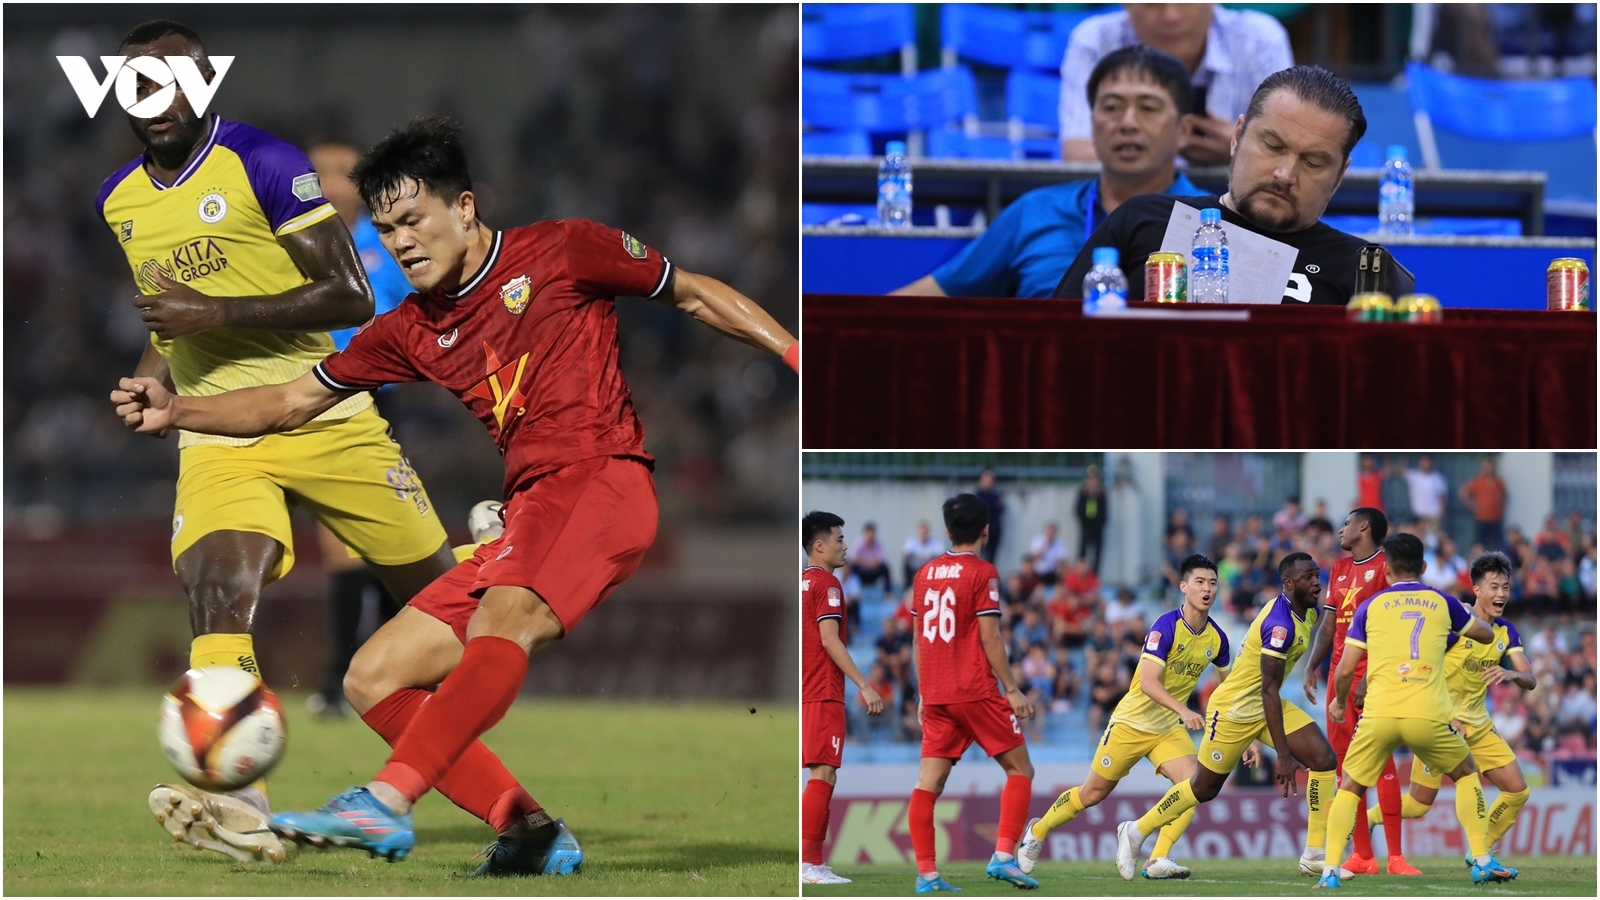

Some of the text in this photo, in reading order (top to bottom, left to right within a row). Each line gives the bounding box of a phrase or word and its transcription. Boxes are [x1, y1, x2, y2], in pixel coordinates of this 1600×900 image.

[181, 257, 228, 282] GROUP
[923, 586, 956, 644] 26
[1400, 611, 1425, 660] 7
[832, 735, 840, 757] 4
